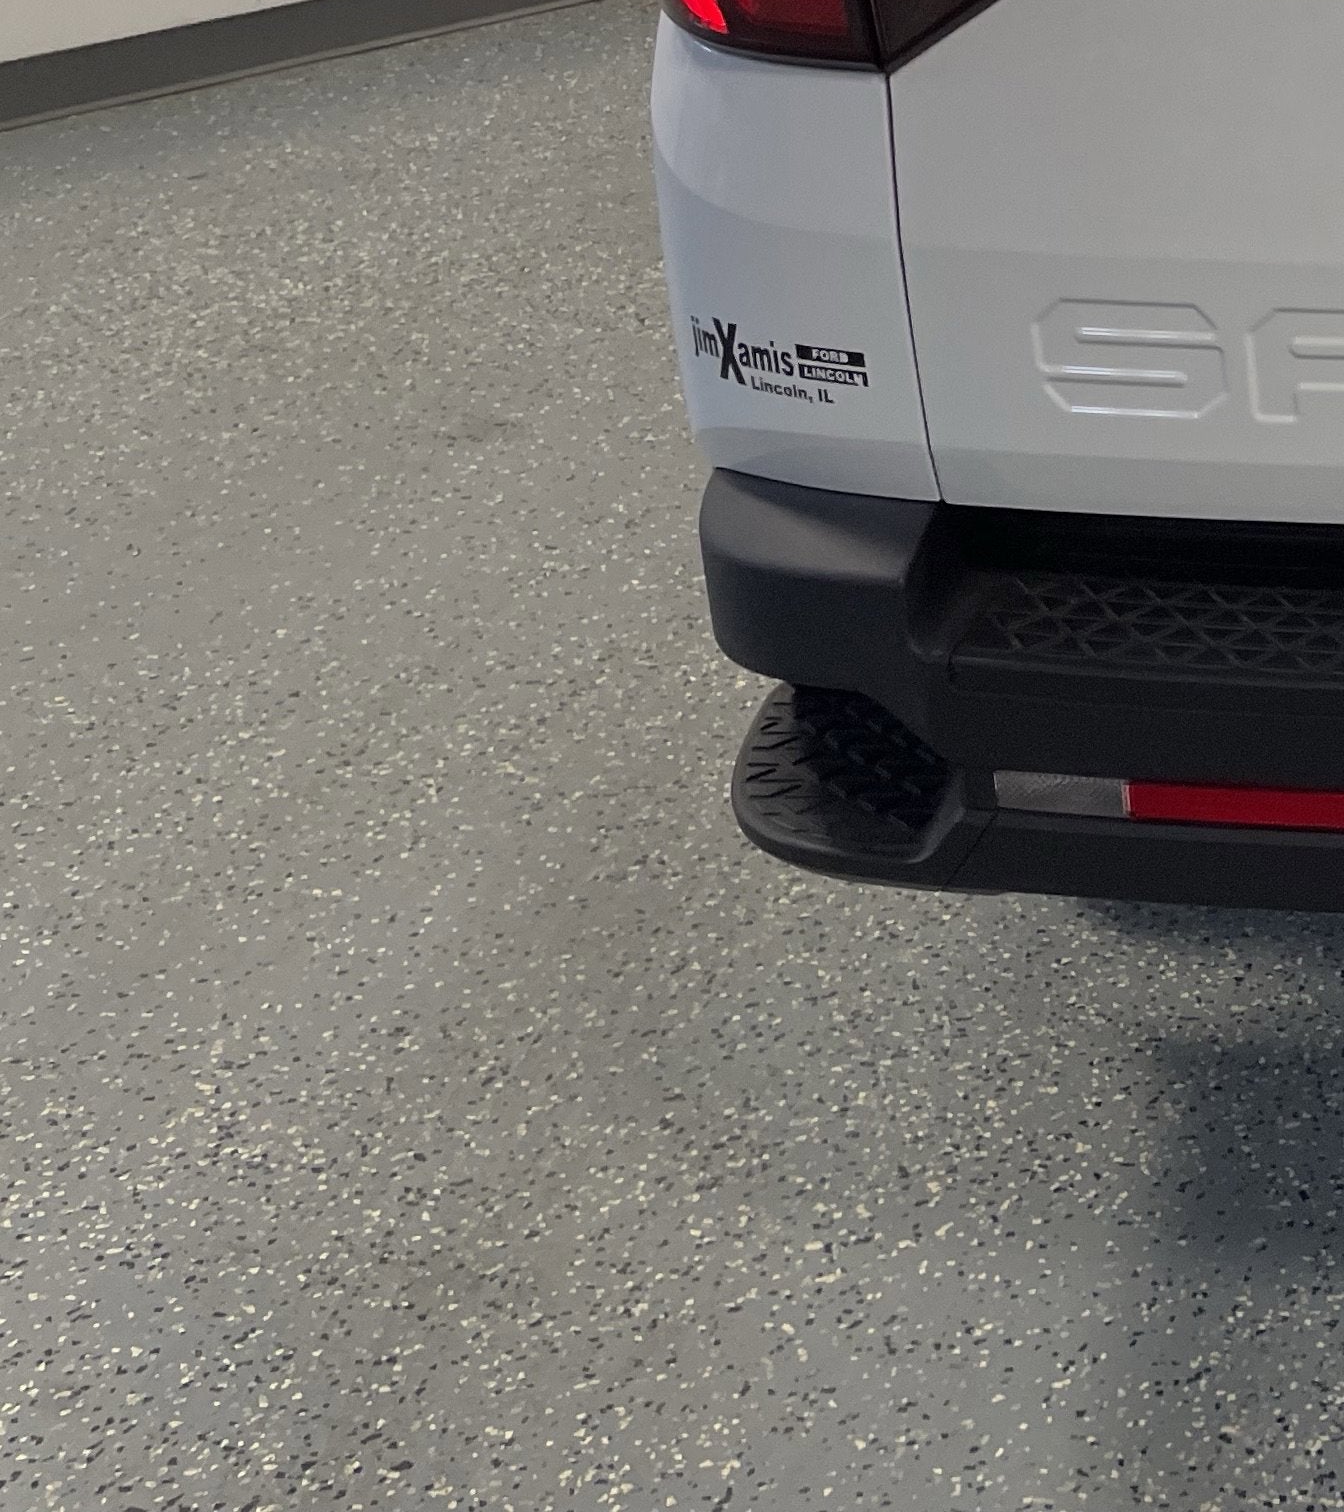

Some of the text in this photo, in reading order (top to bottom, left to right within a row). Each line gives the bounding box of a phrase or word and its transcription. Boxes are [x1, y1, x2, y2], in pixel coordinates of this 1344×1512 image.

[811, 348, 849, 363] FORD
[803, 366, 863, 384] LINCOLN
[750, 375, 835, 404] Lincoln, IL
